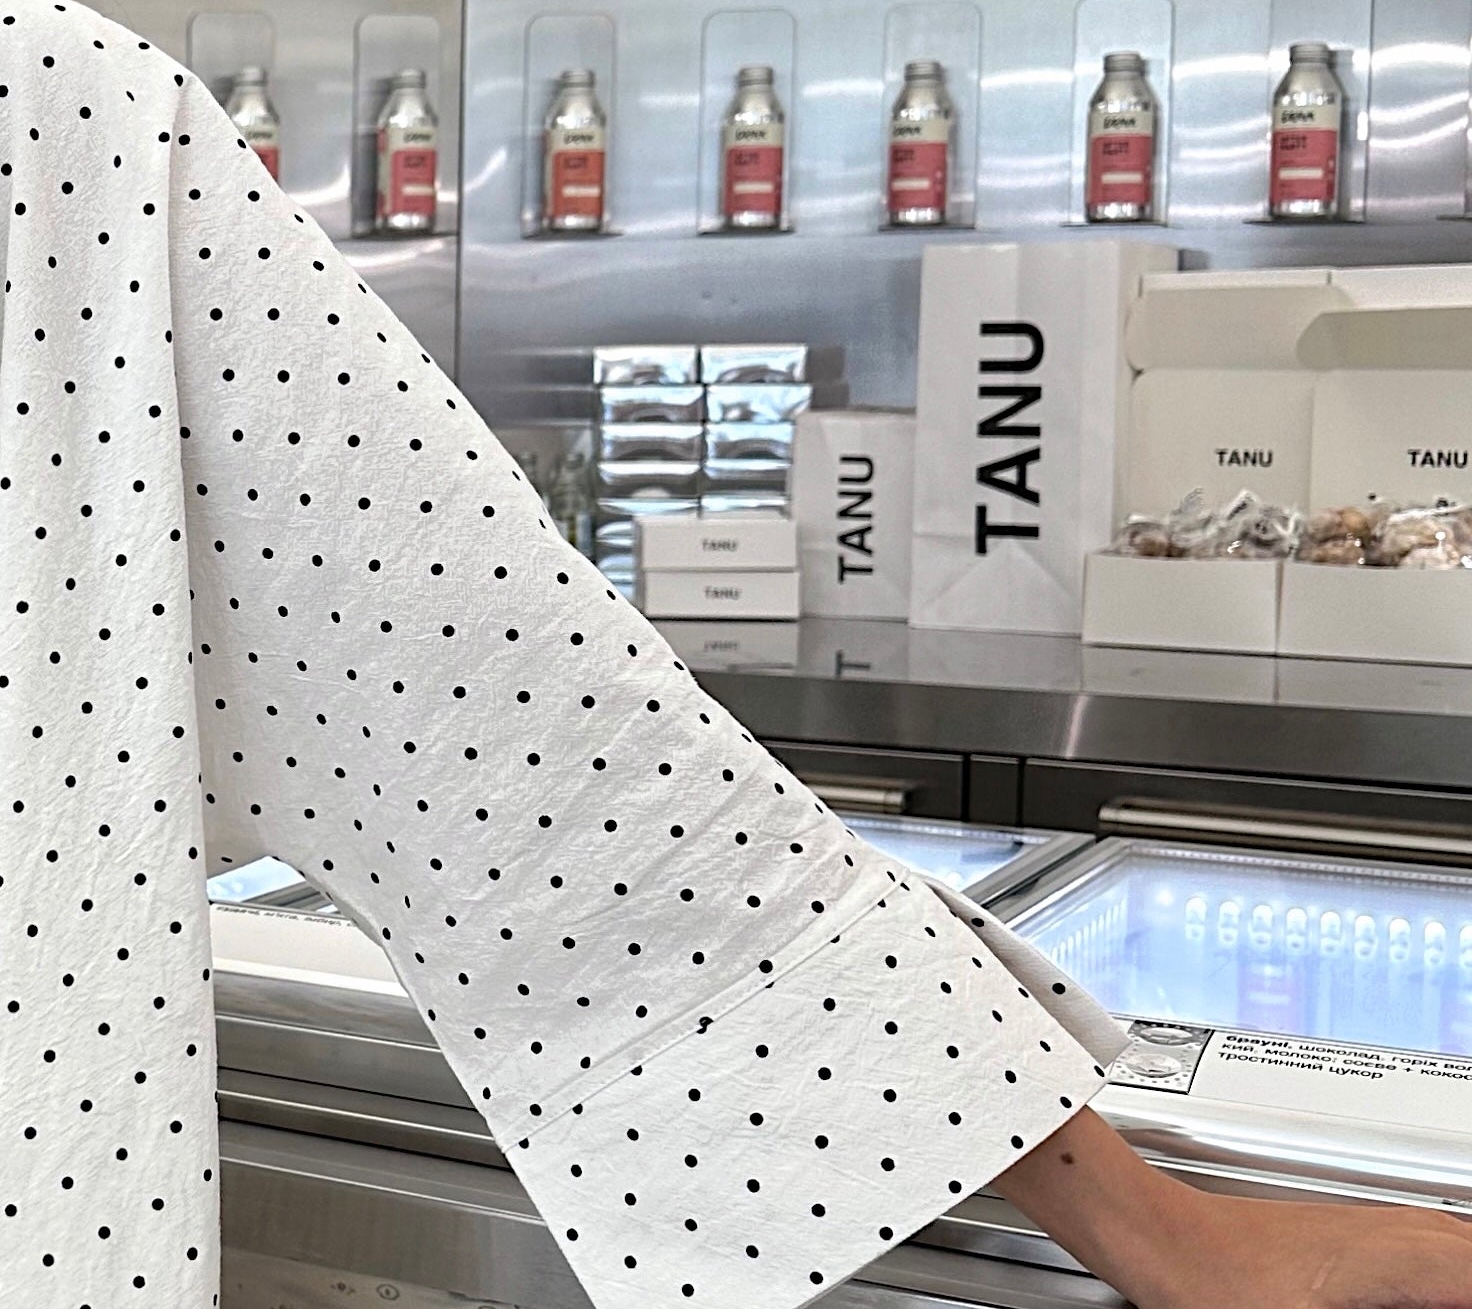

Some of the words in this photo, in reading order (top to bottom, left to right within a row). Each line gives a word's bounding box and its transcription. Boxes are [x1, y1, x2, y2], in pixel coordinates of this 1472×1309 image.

[974, 321, 1045, 556] TANU
[1215, 448, 1274, 468] TANU
[1407, 449, 1469, 469] TANU
[837, 456, 874, 584] TANU
[1218, 1051, 1324, 1072] тростинний
[1328, 1066, 1384, 1080] цукор
